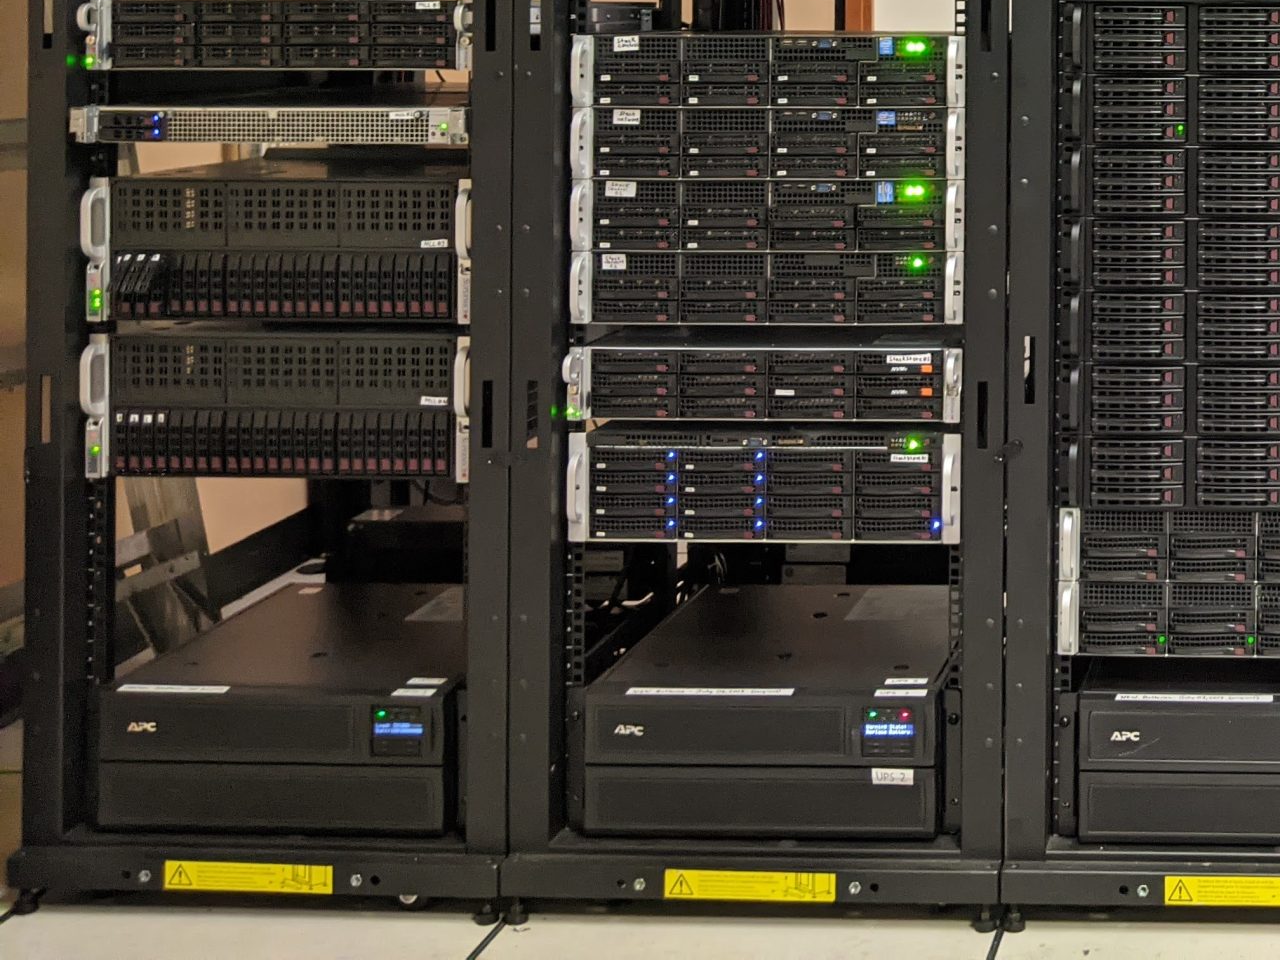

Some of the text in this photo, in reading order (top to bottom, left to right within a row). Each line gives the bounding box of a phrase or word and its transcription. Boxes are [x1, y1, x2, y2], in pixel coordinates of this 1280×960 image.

[127, 722, 158, 732] APC
[614, 724, 645, 736] APC
[1110, 730, 1141, 741] APC
[875, 771, 907, 783] UPS 2
